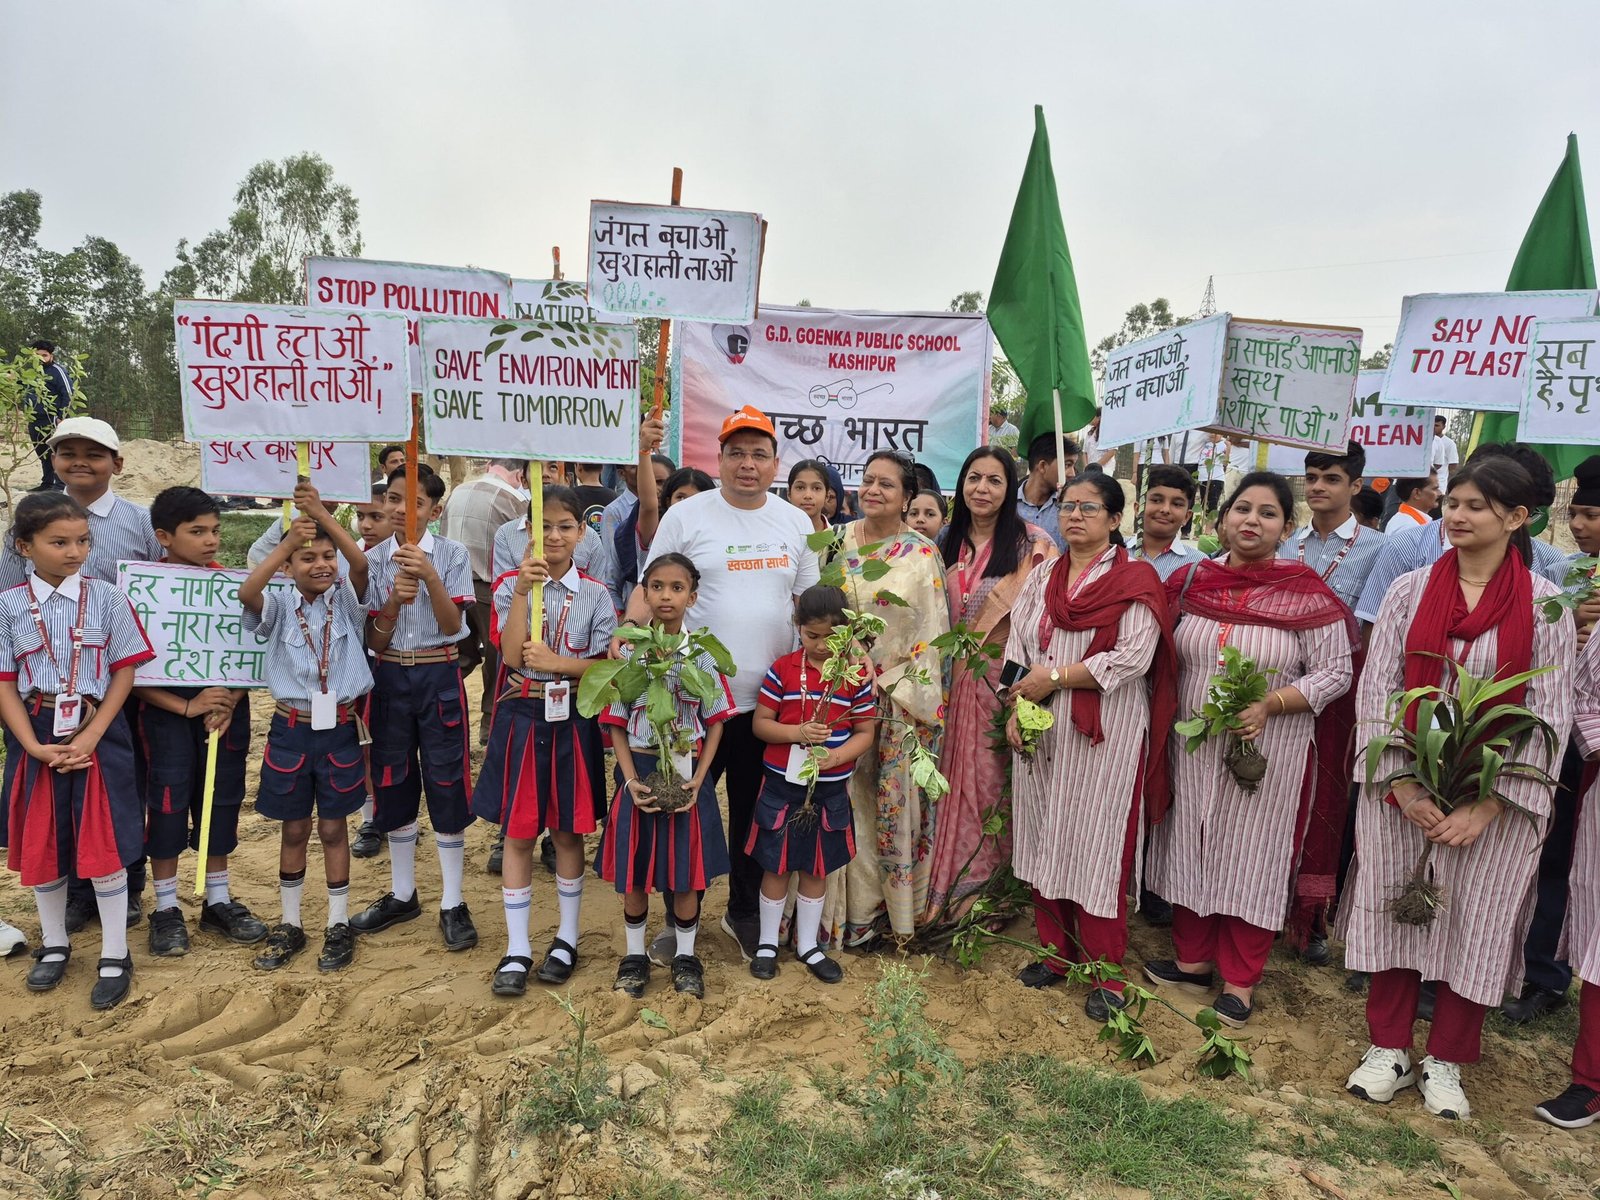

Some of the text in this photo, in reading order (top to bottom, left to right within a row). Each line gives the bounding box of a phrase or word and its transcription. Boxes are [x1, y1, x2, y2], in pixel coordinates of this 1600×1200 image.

[595, 216, 736, 255] जंगल बचाओ,
[318, 276, 507, 320] STOP POLLUTION.
[514, 302, 600, 323] NATURE
[765, 325, 961, 352] G.D. GOENKA PUBLIC SCHOOL
[1431, 317, 1483, 343] SAY
[433, 348, 638, 390] SAVE ENVIRONMENT
[828, 353, 896, 372] KASHIPUR
[1109, 355, 1134, 381] जल
[1411, 348, 1527, 378] TO PLAST
[1105, 384, 1132, 410] कल
[1230, 368, 1284, 401] स्वस्थ
[433, 388, 624, 428] SAVE TOMORROW
[844, 417, 928, 453] भारत
[1350, 424, 1424, 446] CLEAN
[726, 554, 789, 572] स्वच्छता साथी
[164, 641, 266, 681] देश हमा
